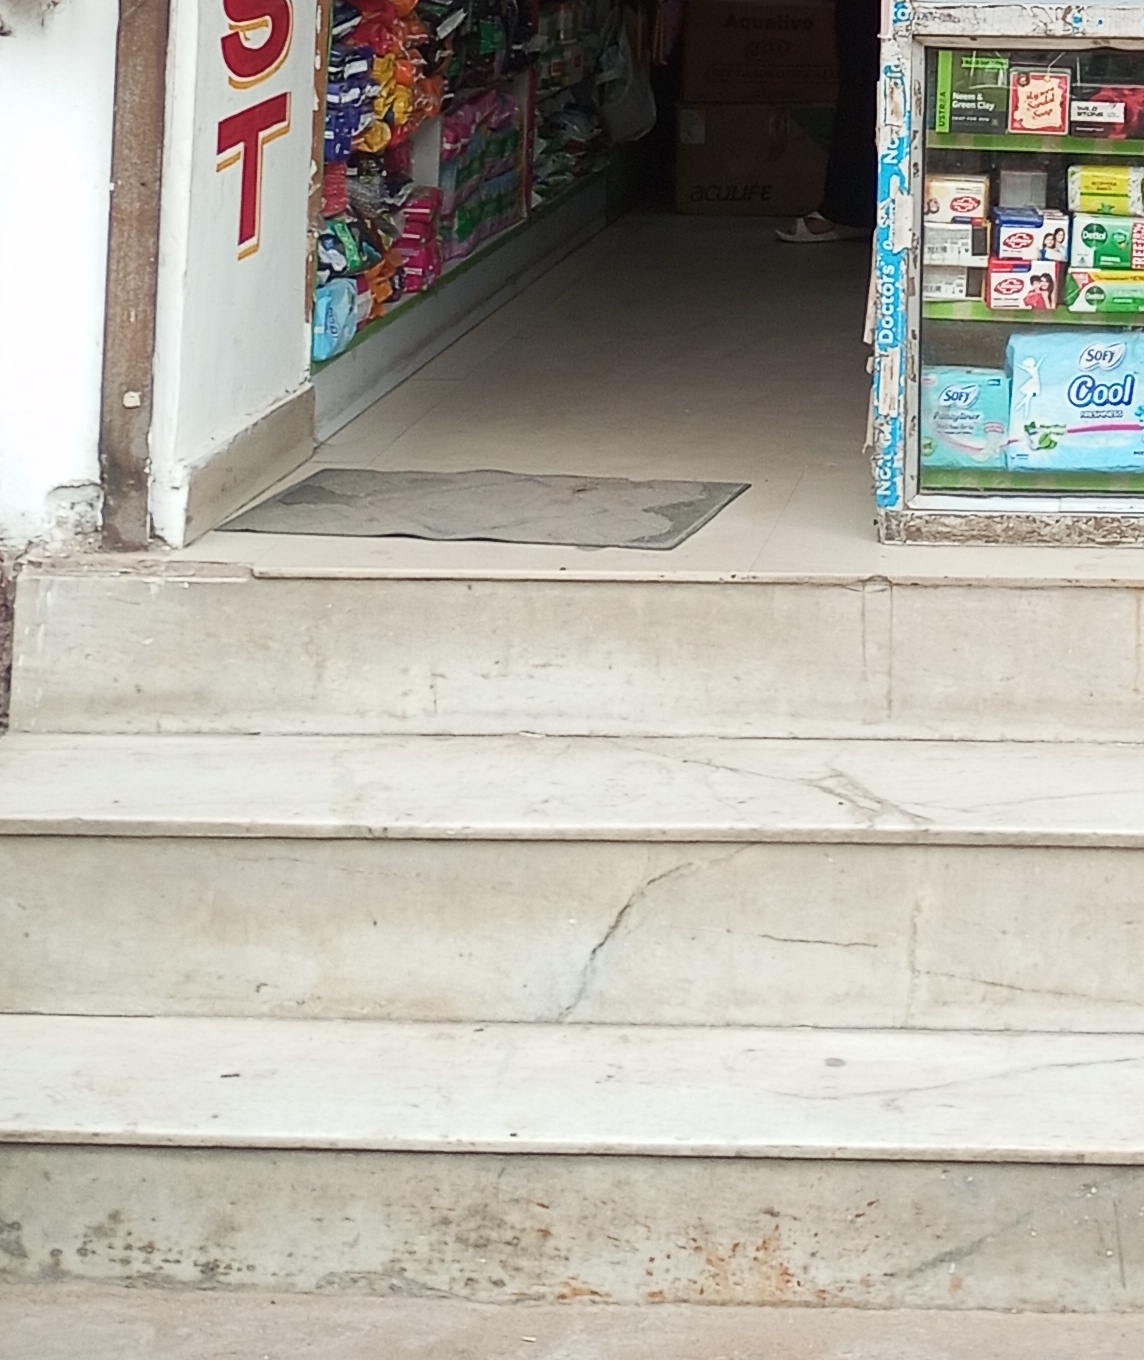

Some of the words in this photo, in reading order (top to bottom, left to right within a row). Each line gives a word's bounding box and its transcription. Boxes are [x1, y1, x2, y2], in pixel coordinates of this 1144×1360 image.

[952, 92, 976, 101] Neem
[952, 100, 976, 109] Green
[977, 101, 995, 111] Clay
[1082, 229, 1107, 240] Dettol
[1085, 348, 1117, 363] SOFY
[1066, 374, 1137, 409] Cool
